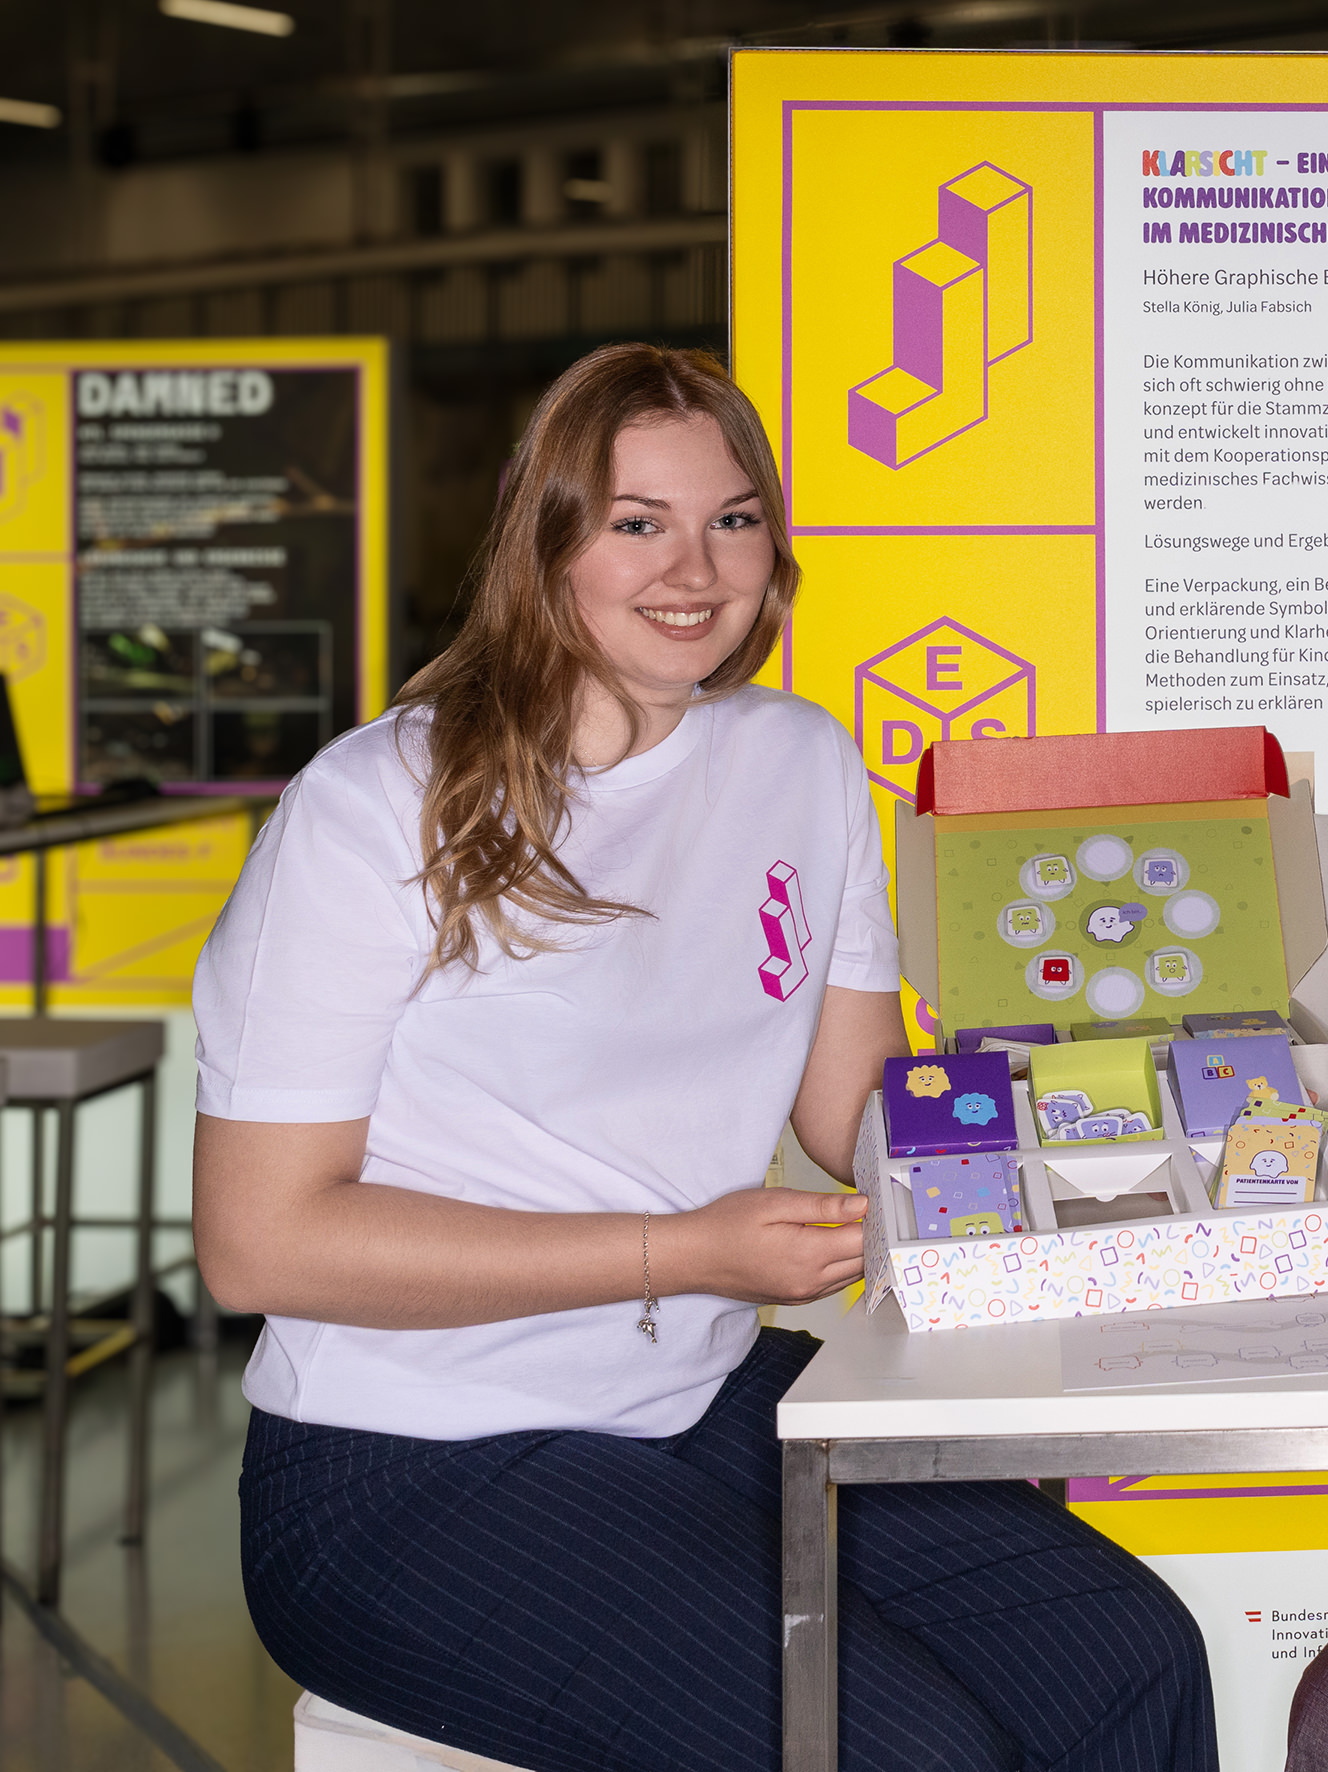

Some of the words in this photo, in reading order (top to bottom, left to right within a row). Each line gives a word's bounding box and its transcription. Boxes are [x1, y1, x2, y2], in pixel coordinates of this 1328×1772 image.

[1141, 149, 1267, 177] KLARSICHT
[1142, 221, 1172, 243] IM
[1143, 268, 1209, 285] Höhere
[1214, 268, 1318, 289] Graphische
[1142, 300, 1179, 313] Stella
[1183, 300, 1223, 316] König,
[1225, 300, 1257, 312] Julia
[1260, 300, 1311, 312] Fabsich
[1143, 353, 1169, 368] Die
[1173, 353, 1298, 368] Kommunikation
[78, 370, 273, 415] DAMNED
[1143, 377, 1174, 392] sich
[1179, 376, 1202, 392] oft
[1205, 377, 1280, 395] schwierig
[1284, 377, 1324, 391] ohne
[1143, 400, 1207, 418] konzept
[1210, 400, 1233, 415] für
[1236, 400, 1261, 415] die
[1143, 424, 1173, 439] und
[1178, 424, 1260, 439] entwickelt
[1144, 448, 1170, 462] mit
[1173, 447, 1208, 462] dem
[1144, 471, 1258, 486] medizinisches
[1144, 534, 1249, 552] Lösungswege
[1253, 532, 1283, 547] und
[1145, 578, 1179, 592] Eine
[1182, 577, 1281, 595] Verpackung,
[1285, 577, 1309, 591] ein
[1145, 601, 1174, 616] und
[1179, 600, 1265, 616] erklärende
[1145, 625, 1246, 643] Orientierung
[1250, 624, 1279, 639] und
[1145, 649, 1169, 663] die
[1174, 648, 1269, 666] Behandlung
[1272, 647, 1295, 662] für
[926, 645, 963, 691] E
[1145, 672, 1225, 687] Methoden
[1230, 675, 1263, 686] zum
[1268, 671, 1328, 687] Einsatz,
[1145, 695, 1231, 714] spielerisch
[1236, 699, 1253, 710] zu
[1257, 695, 1322, 710] erklären
[882, 720, 924, 765] D
[1271, 1646, 1297, 1659] und
